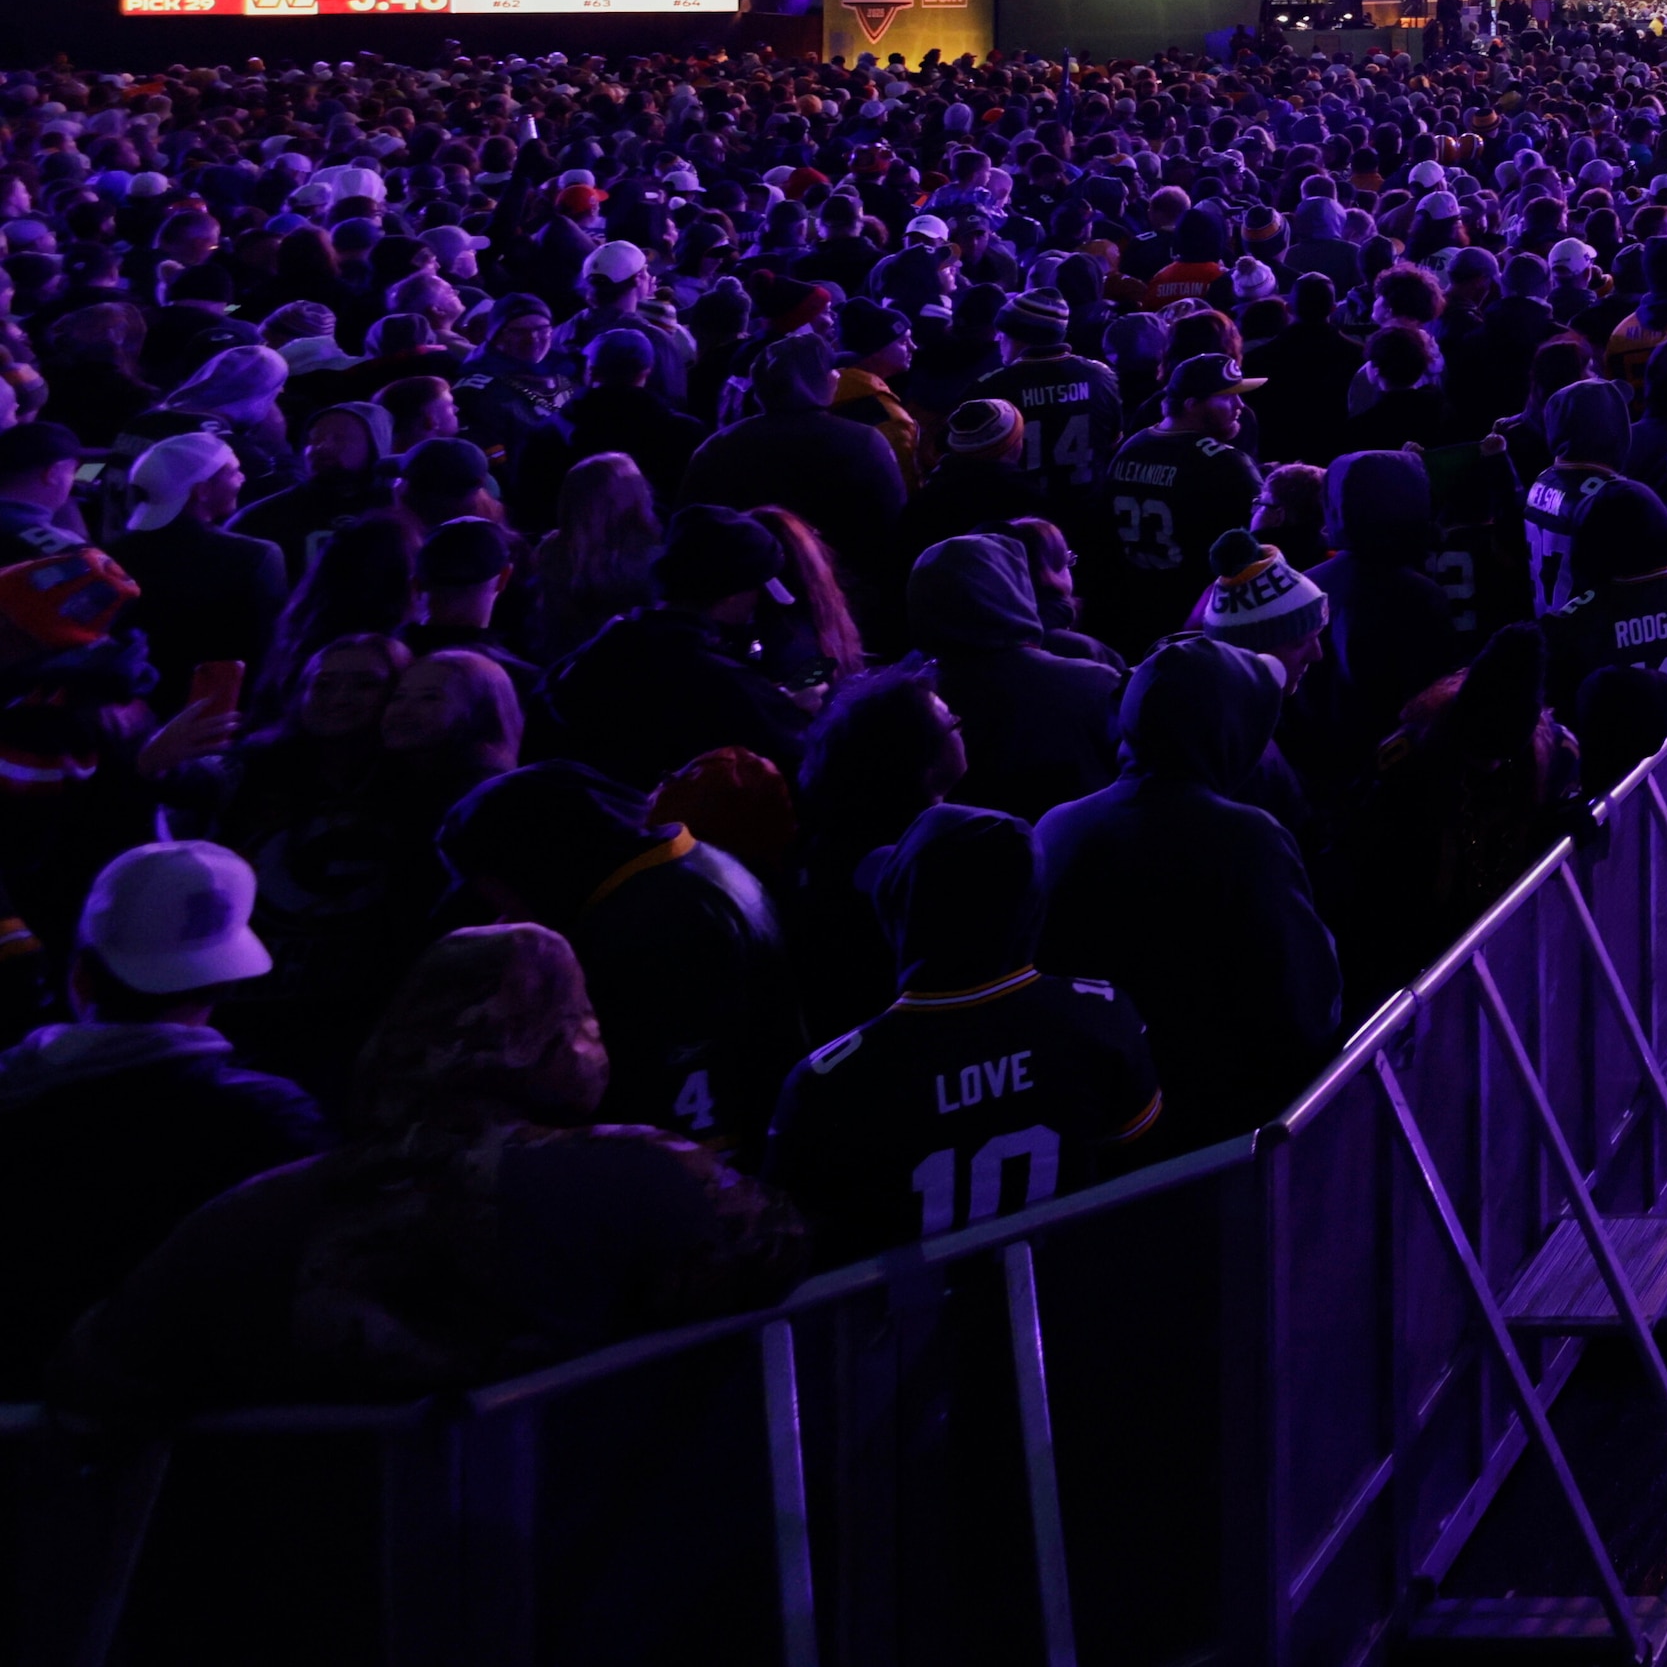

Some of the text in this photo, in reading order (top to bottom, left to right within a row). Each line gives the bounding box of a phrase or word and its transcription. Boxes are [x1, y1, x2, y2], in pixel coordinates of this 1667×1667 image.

[493, 0, 521, 8] #62
[583, 0, 611, 8] #63
[673, 0, 701, 8] #64
[1021, 382, 1090, 408] HUTSON
[1022, 413, 1094, 485] 14
[1114, 460, 1178, 488] ALEXANDER
[936, 1049, 1034, 1115] LOVE
[673, 1070, 716, 1131] 4
[910, 1123, 1062, 1237] 10
